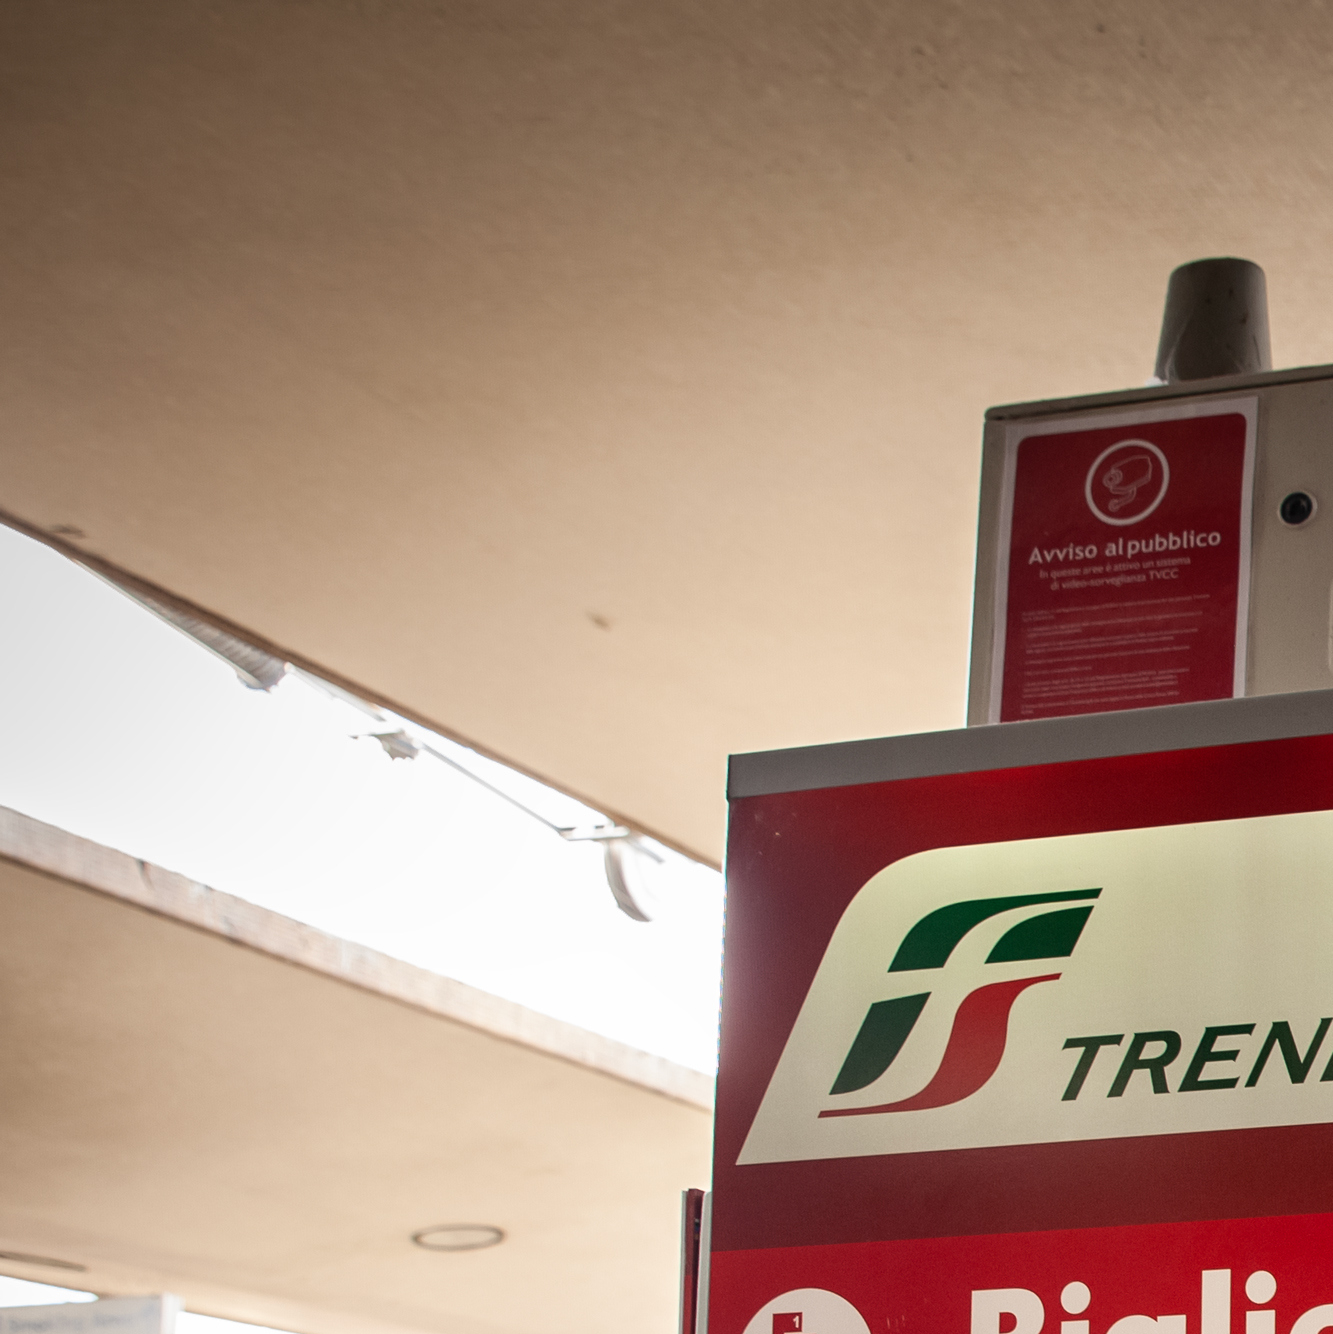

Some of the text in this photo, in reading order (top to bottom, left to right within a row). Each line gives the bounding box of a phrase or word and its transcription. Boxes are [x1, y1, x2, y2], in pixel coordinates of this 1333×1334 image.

[1028, 530, 1222, 566] Avviso al pubblico
[1051, 566, 1081, 580] queste
[1149, 568, 1179, 580] TVCC
